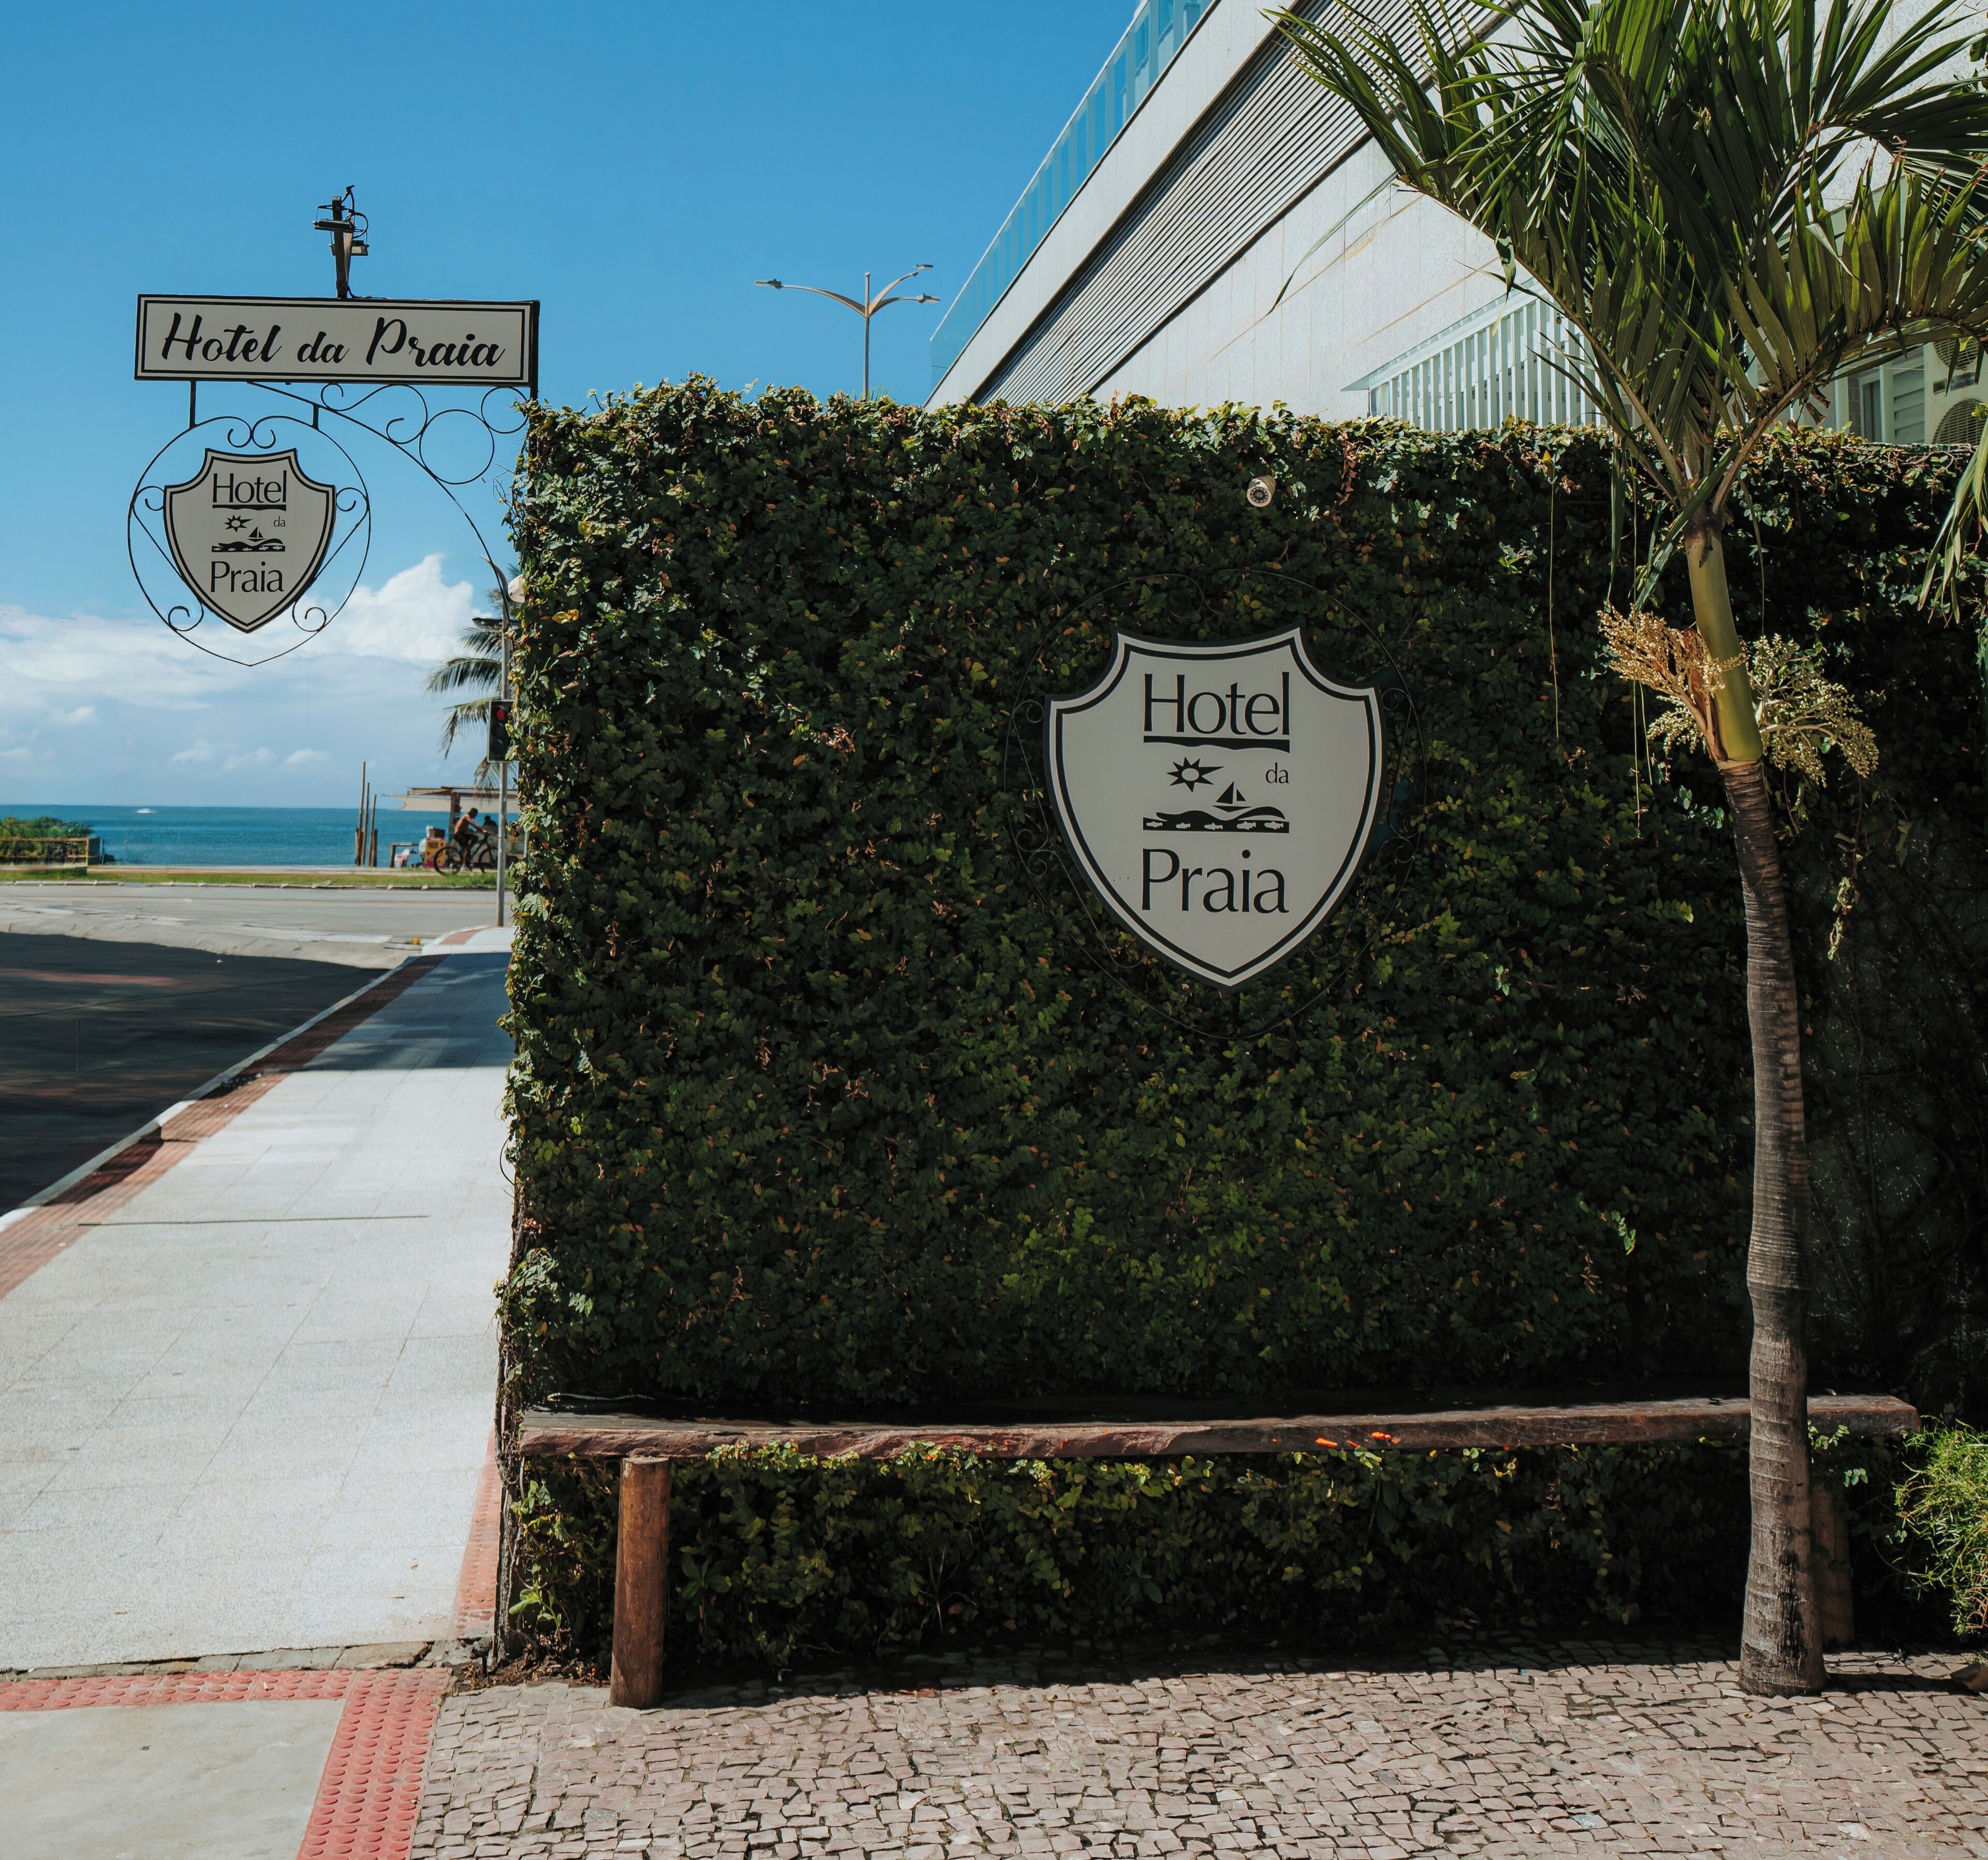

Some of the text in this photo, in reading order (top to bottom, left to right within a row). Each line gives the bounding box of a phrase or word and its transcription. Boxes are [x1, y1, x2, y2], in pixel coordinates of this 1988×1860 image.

[161, 312, 506, 367] Hotel da Praia
[212, 470, 287, 503] Hotel
[273, 516, 286, 527] da
[210, 561, 285, 593] Praia
[1143, 671, 1290, 735] Hotel
[1265, 762, 1290, 784] da
[1141, 848, 1290, 913] Praia
